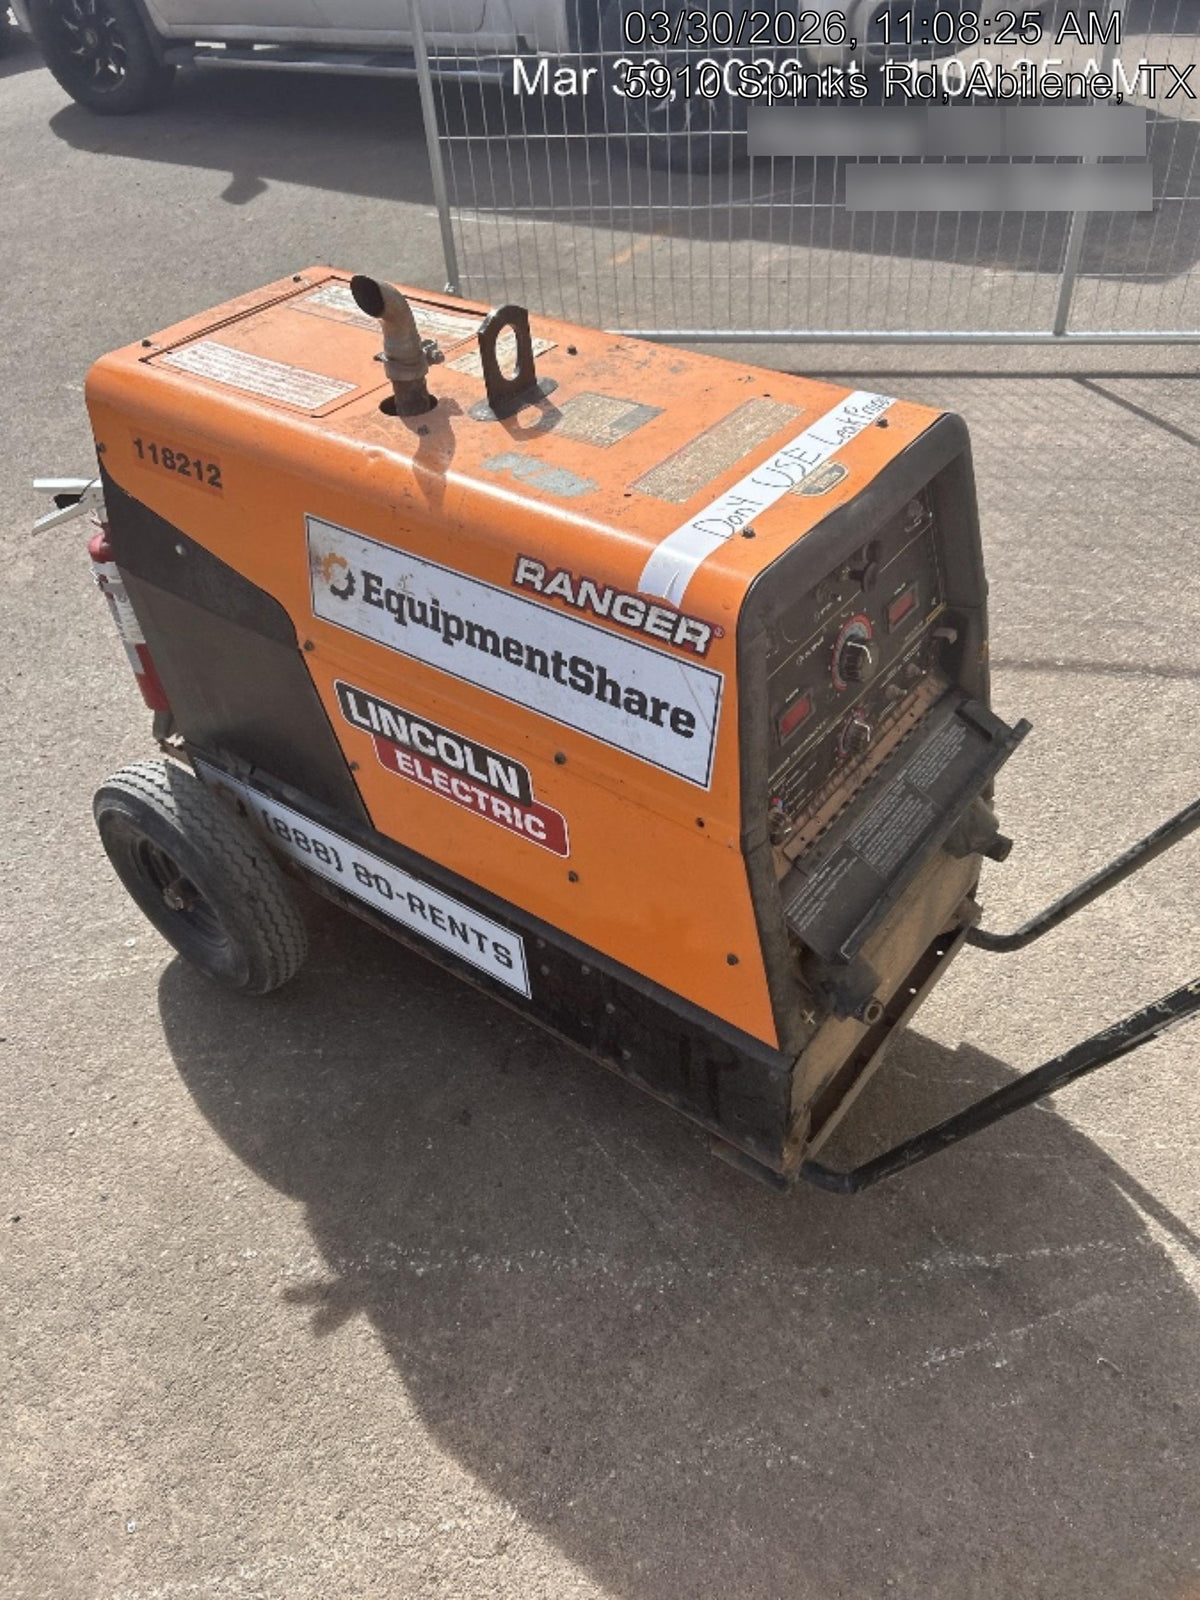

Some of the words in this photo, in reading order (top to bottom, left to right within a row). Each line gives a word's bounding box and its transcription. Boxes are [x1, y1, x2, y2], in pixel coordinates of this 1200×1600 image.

[132, 437, 224, 491] 118212
[360, 570, 697, 740] EquipmentShare
[513, 557, 712, 654] RANGER
[345, 691, 520, 799] LINCOLN
[395, 750, 548, 841] ELECTRIC
[261, 809, 345, 874] (888)
[352, 859, 514, 971] 80-RENTS
